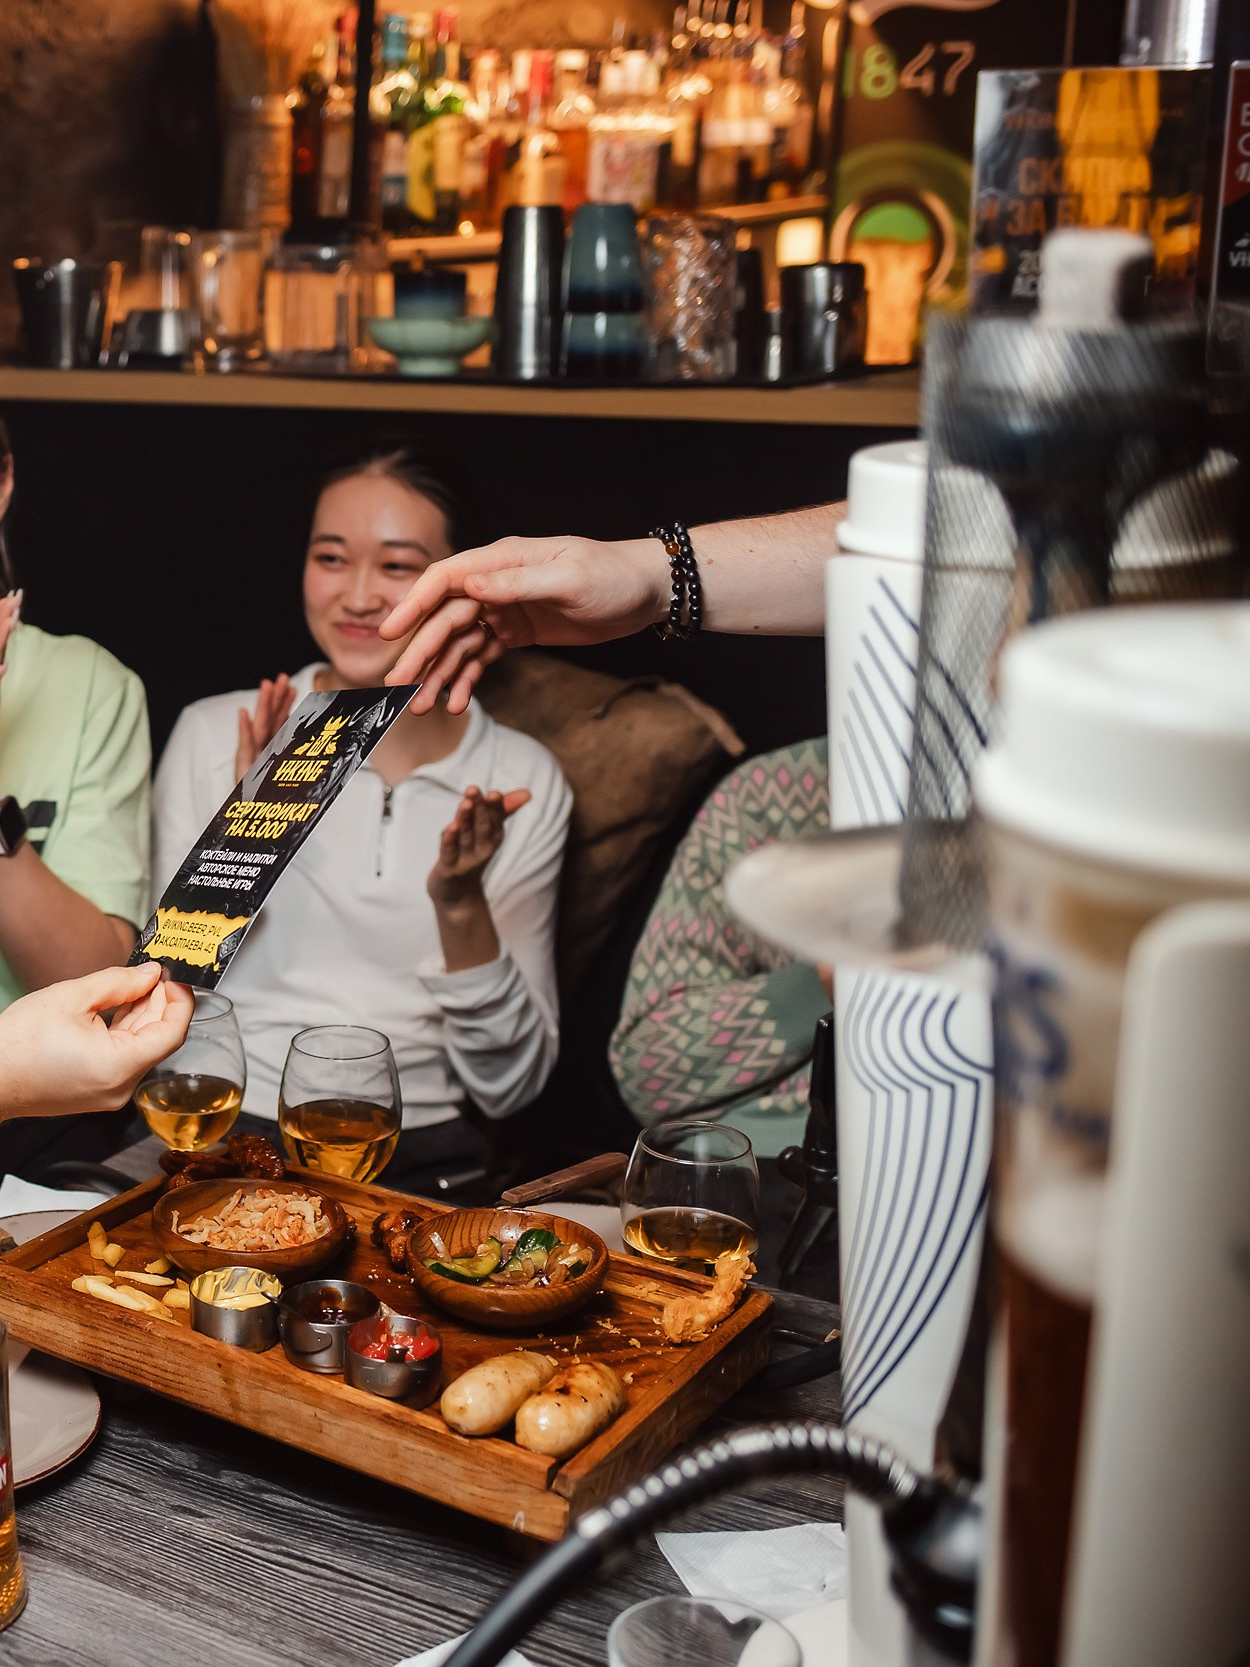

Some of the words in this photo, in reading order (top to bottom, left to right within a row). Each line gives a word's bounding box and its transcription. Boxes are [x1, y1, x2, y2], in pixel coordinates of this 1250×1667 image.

[272, 760, 329, 782] VIKING
[225, 801, 319, 822] СЕРТИФИКАТ
[225, 819, 249, 837] НА
[244, 820, 288, 839] 5.000
[199, 848, 237, 862] КОКТЕЙЛИ
[234, 852, 244, 862] И
[240, 852, 278, 865] НАПИТКИ
[197, 862, 239, 876] АВТОРСКОЕ
[236, 865, 261, 878] МЕНЮ
[187, 874, 235, 889] НАСТОЛЬНЫЕ
[231, 879, 255, 891] ИГРЫ
